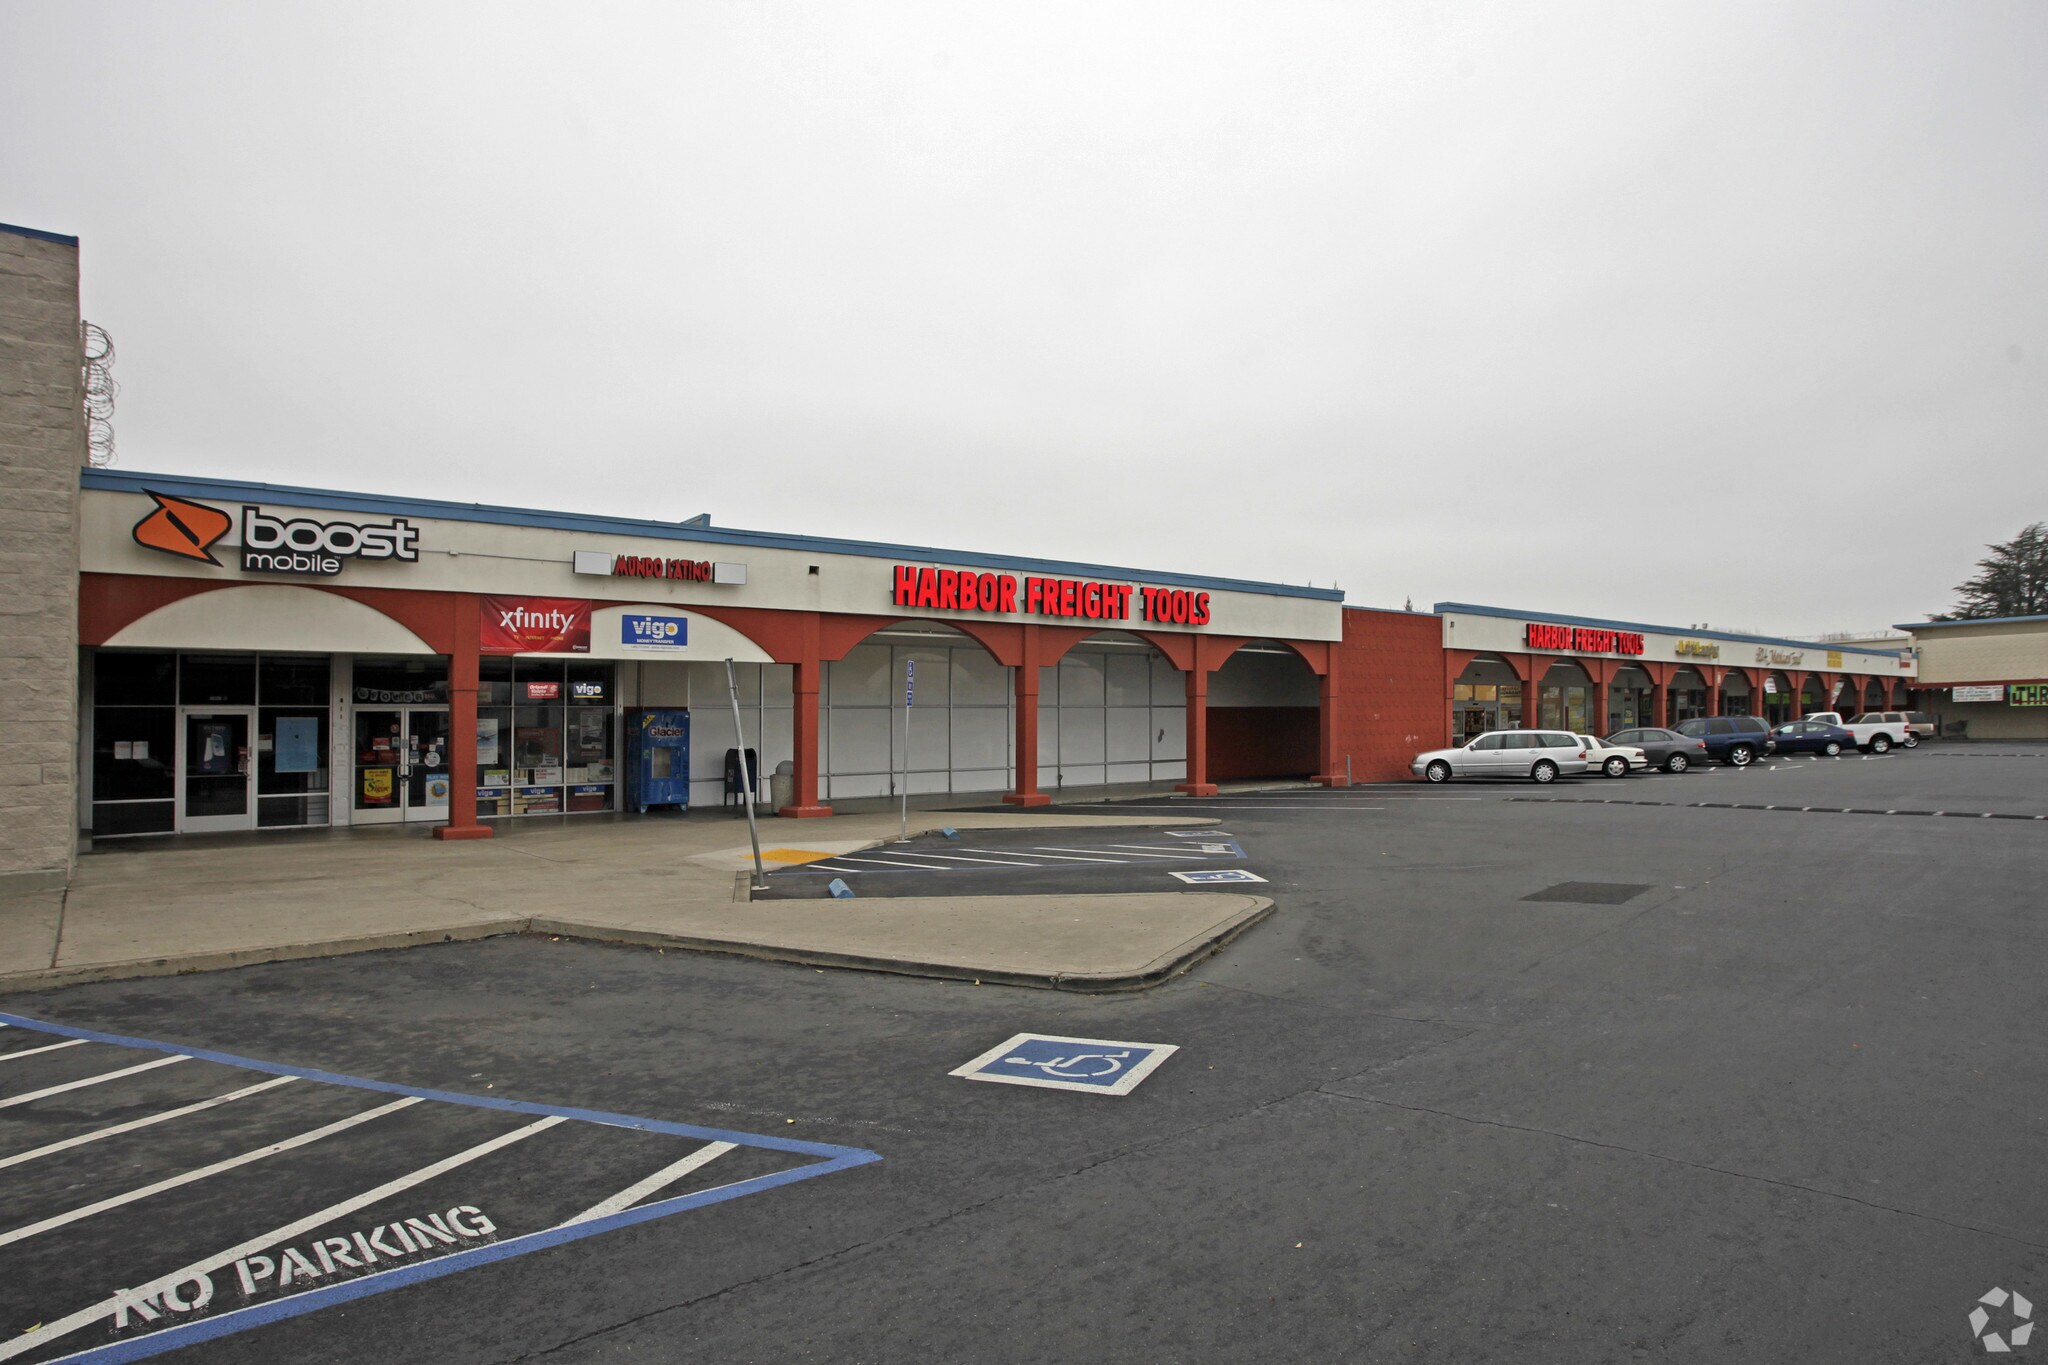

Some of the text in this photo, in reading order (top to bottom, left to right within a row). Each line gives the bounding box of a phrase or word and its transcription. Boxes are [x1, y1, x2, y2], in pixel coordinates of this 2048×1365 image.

[245, 509, 417, 559] boost
[246, 553, 340, 573] mobile
[613, 554, 711, 583] MUNDO LATINO
[894, 565, 1211, 625] HARBOR FREIGHT TOOLS
[500, 606, 575, 634] xfinity
[632, 617, 679, 639] vigo
[1526, 623, 1644, 656] HARBOR FREIGHT TOOLS
[575, 682, 602, 696] vigo
[649, 726, 684, 738] Glacier
[530, 786, 546, 796] vigo
[582, 784, 598, 793] vigo
[110, 1204, 497, 1329] NO PARKING
